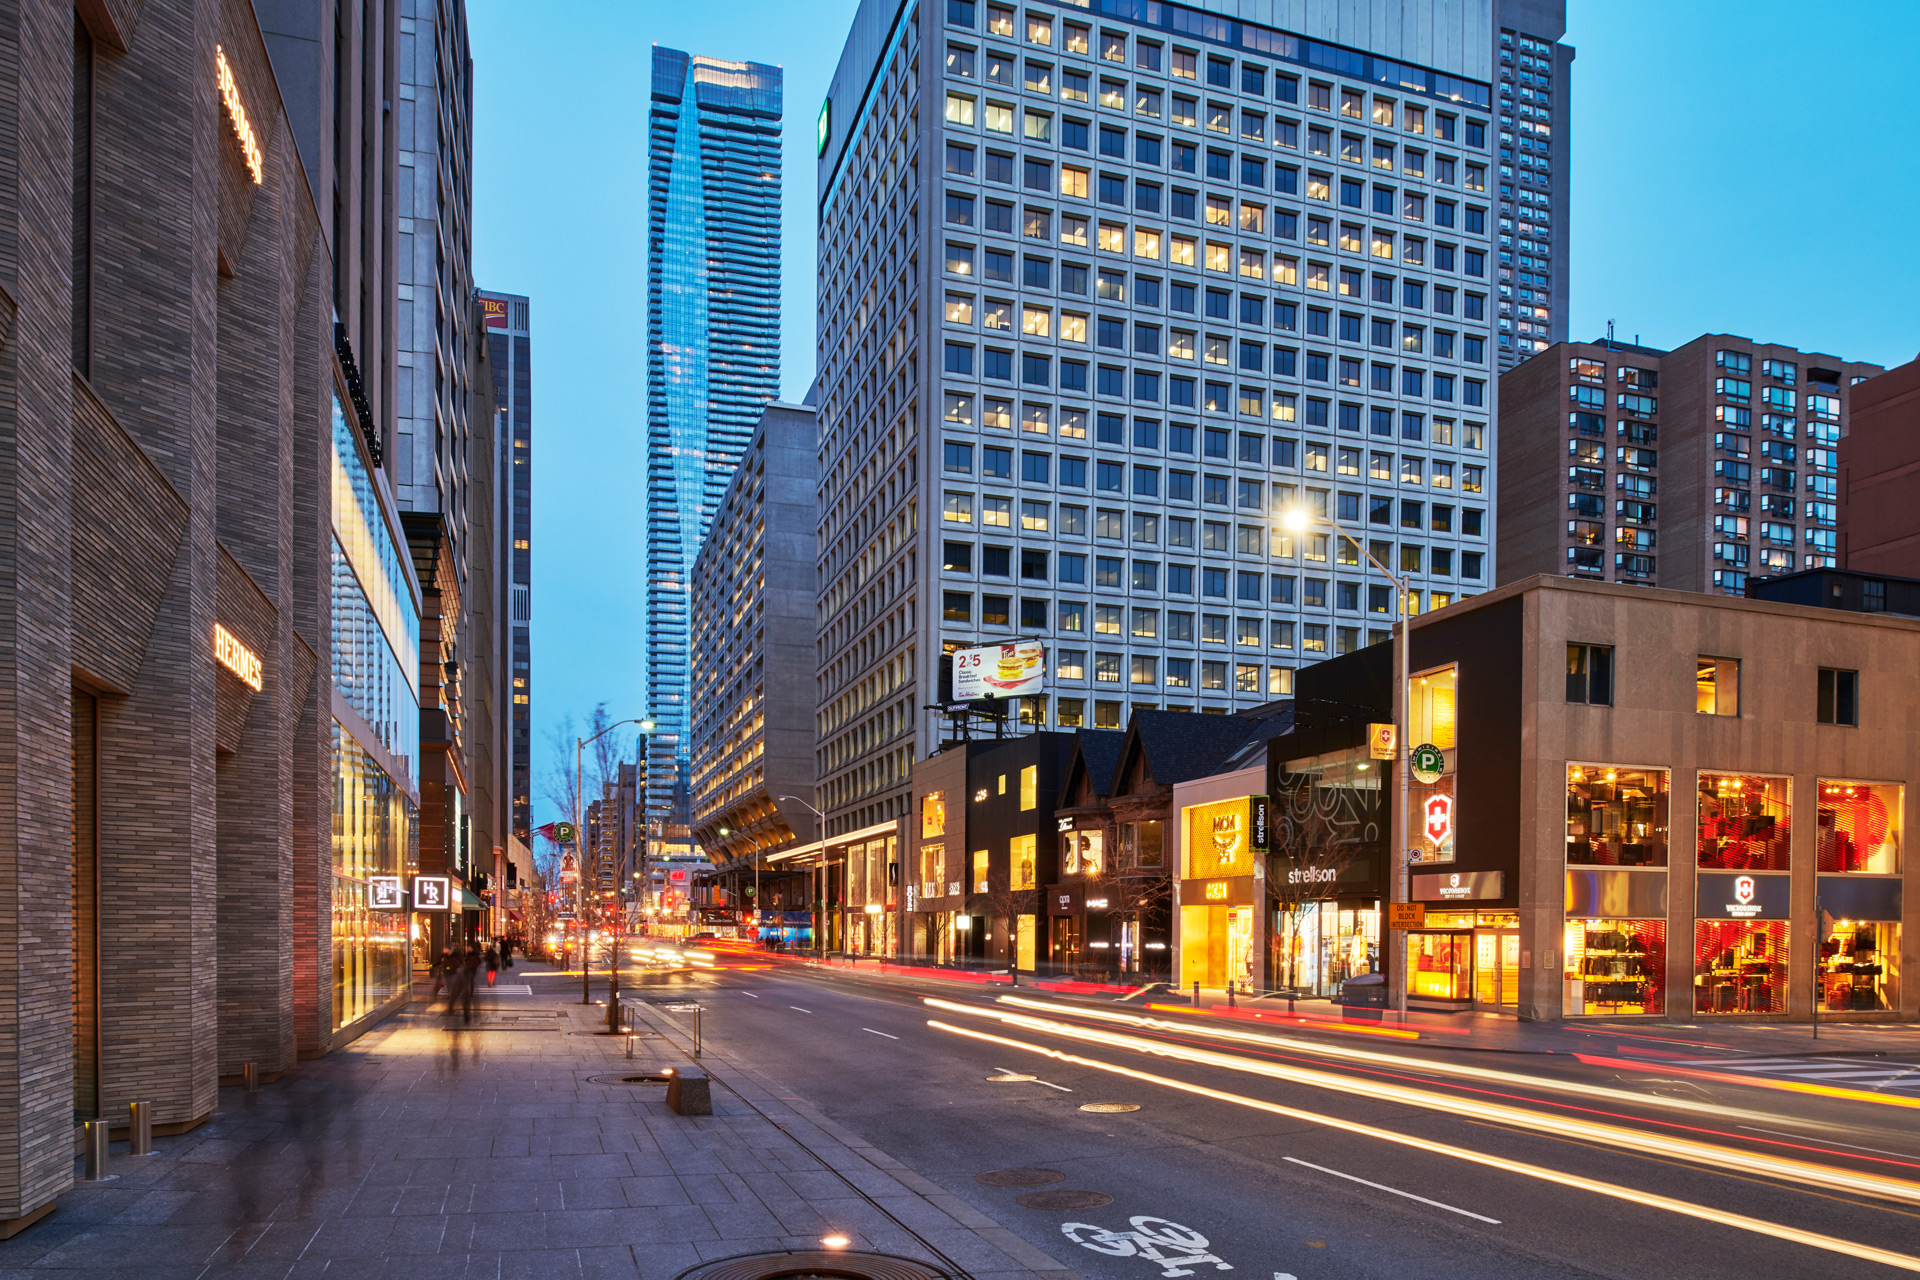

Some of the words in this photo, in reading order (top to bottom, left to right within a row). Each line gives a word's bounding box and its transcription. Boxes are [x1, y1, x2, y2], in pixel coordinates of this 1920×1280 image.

[959, 655, 966, 668] 2
[1422, 753, 1435, 769] P
[560, 827, 569, 836] P
[1213, 814, 1237, 833] MCM
[1288, 866, 1337, 884] strellson
[1206, 882, 1228, 899] MCM
